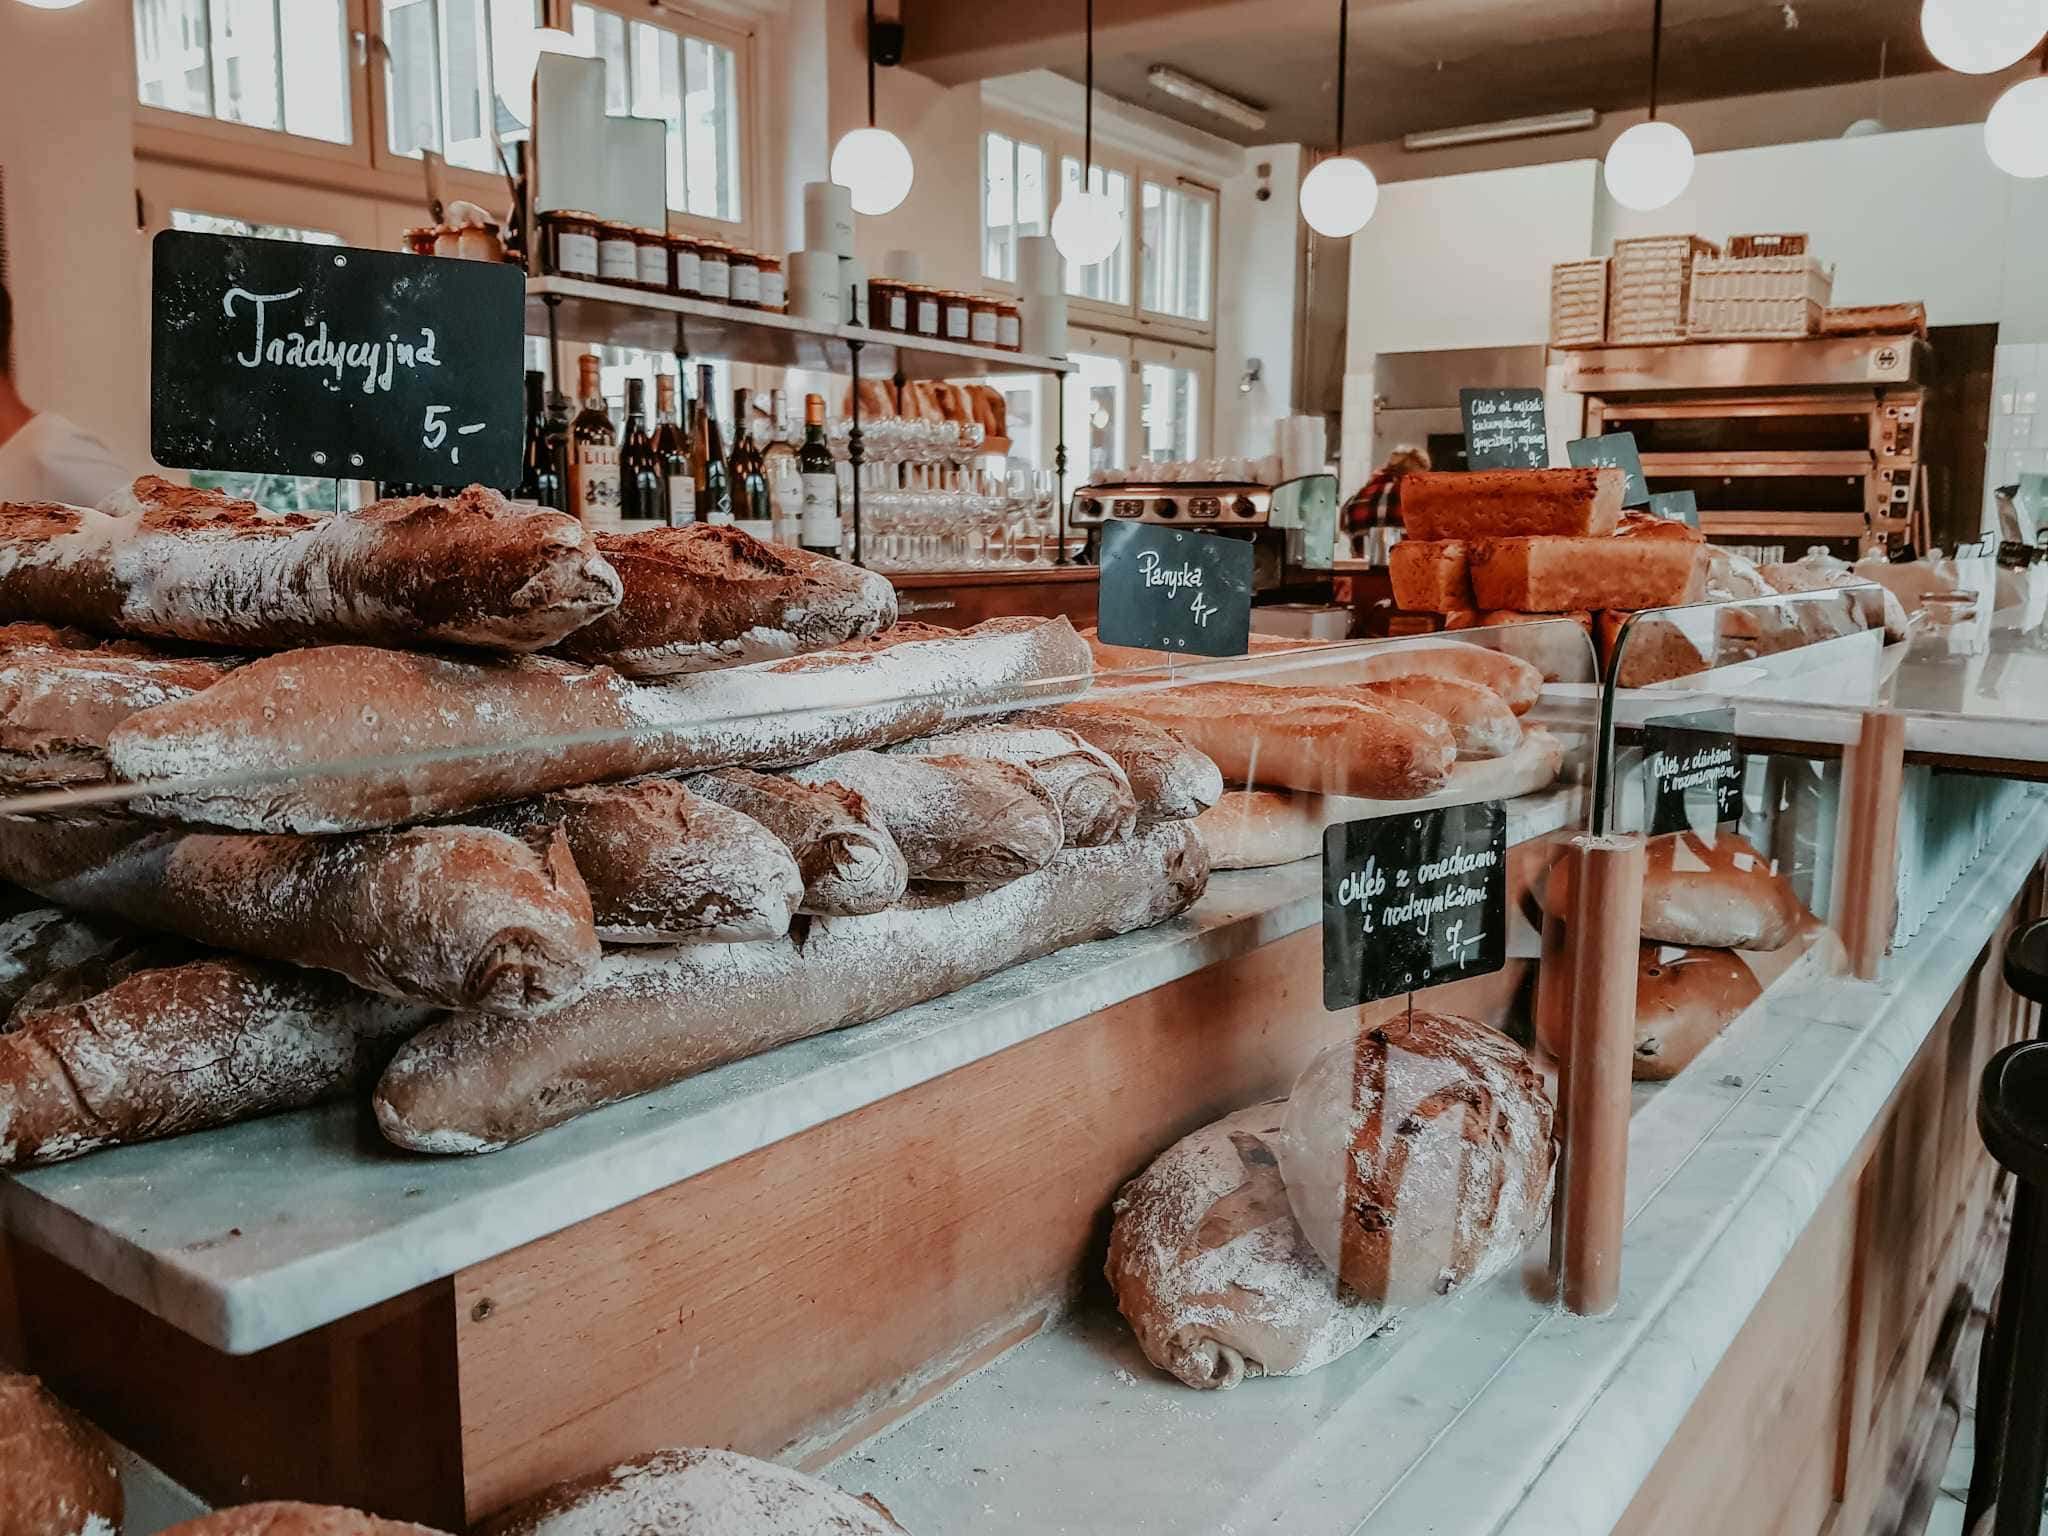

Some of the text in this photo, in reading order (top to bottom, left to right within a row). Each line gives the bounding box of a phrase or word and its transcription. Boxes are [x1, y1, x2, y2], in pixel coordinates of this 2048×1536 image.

[223, 287, 442, 394] Tradycyjna
[1137, 551, 1204, 600] Paryska
[1338, 839, 1498, 911] Chleb z orzechami
[1363, 876, 1489, 936] i rodzynkami
